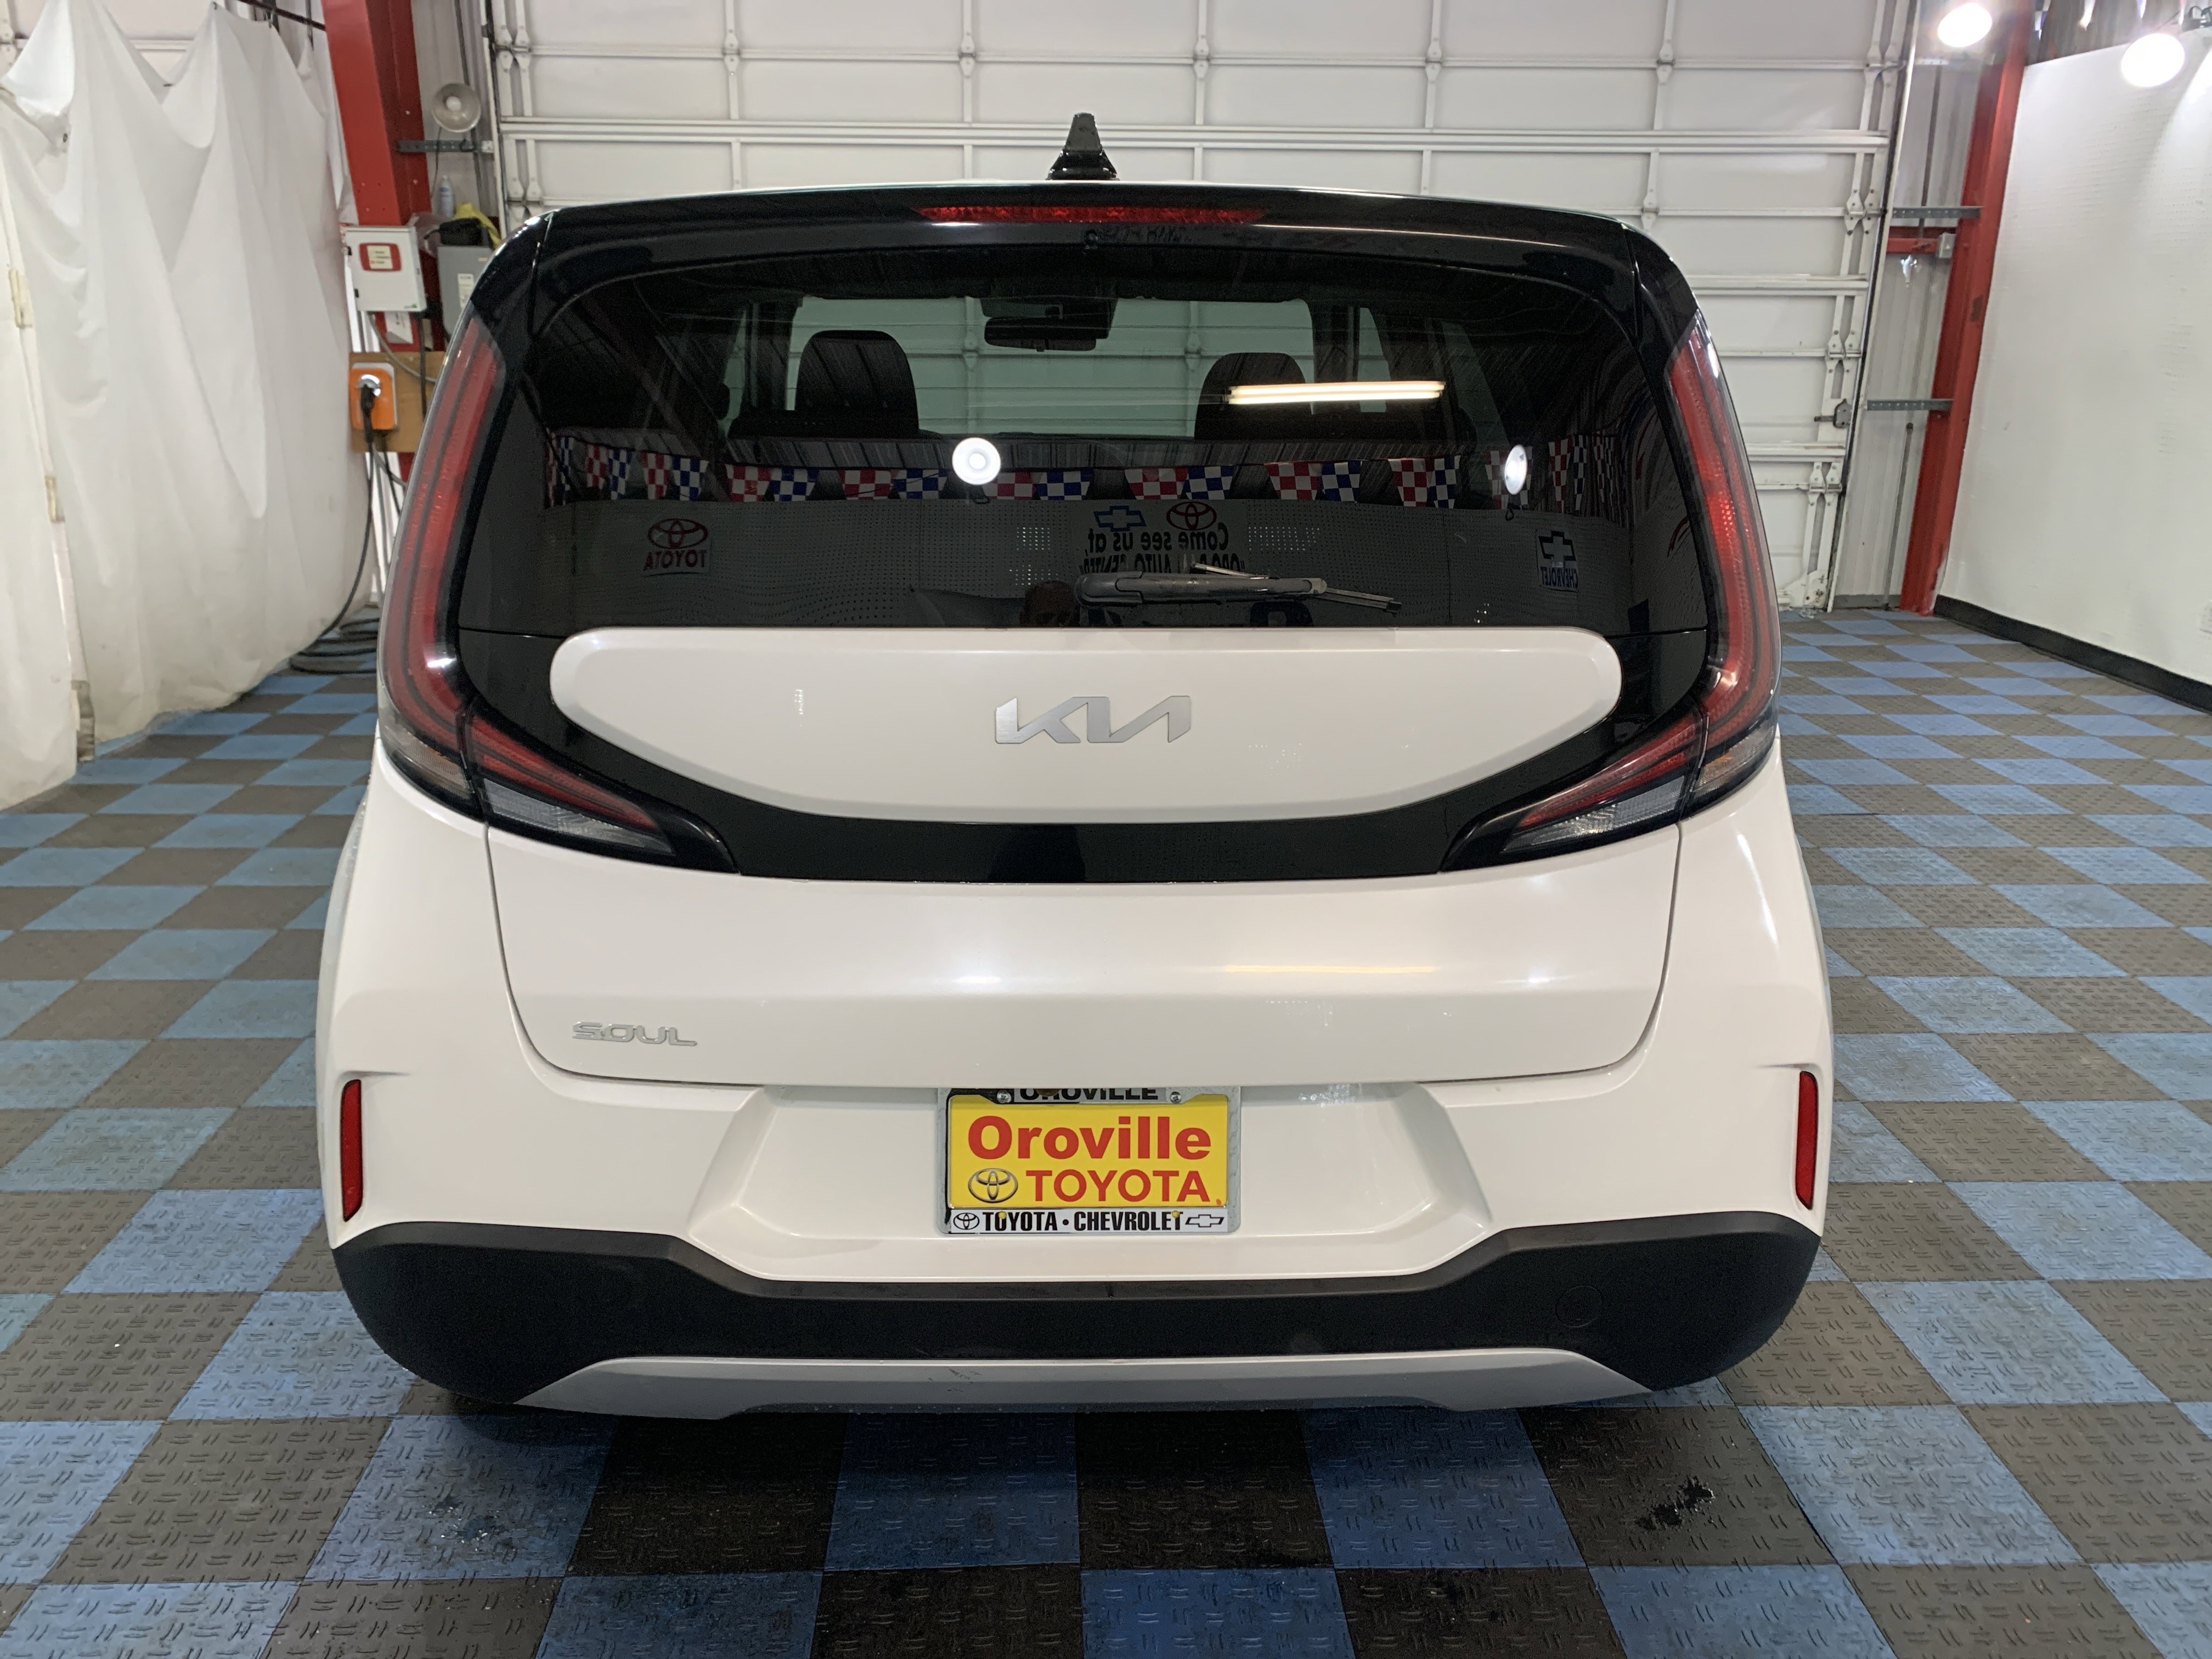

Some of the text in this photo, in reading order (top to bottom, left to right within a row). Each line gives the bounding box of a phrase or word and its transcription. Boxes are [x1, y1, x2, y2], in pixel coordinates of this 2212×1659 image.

[572, 1021, 697, 1046] SOUL
[1019, 1088, 1159, 1101] OOVILLE
[968, 1115, 1211, 1160] Oroville
[1025, 1169, 1211, 1202] TOYOTA
[982, 1210, 1183, 1232] TOYOTA CHEVROLET
